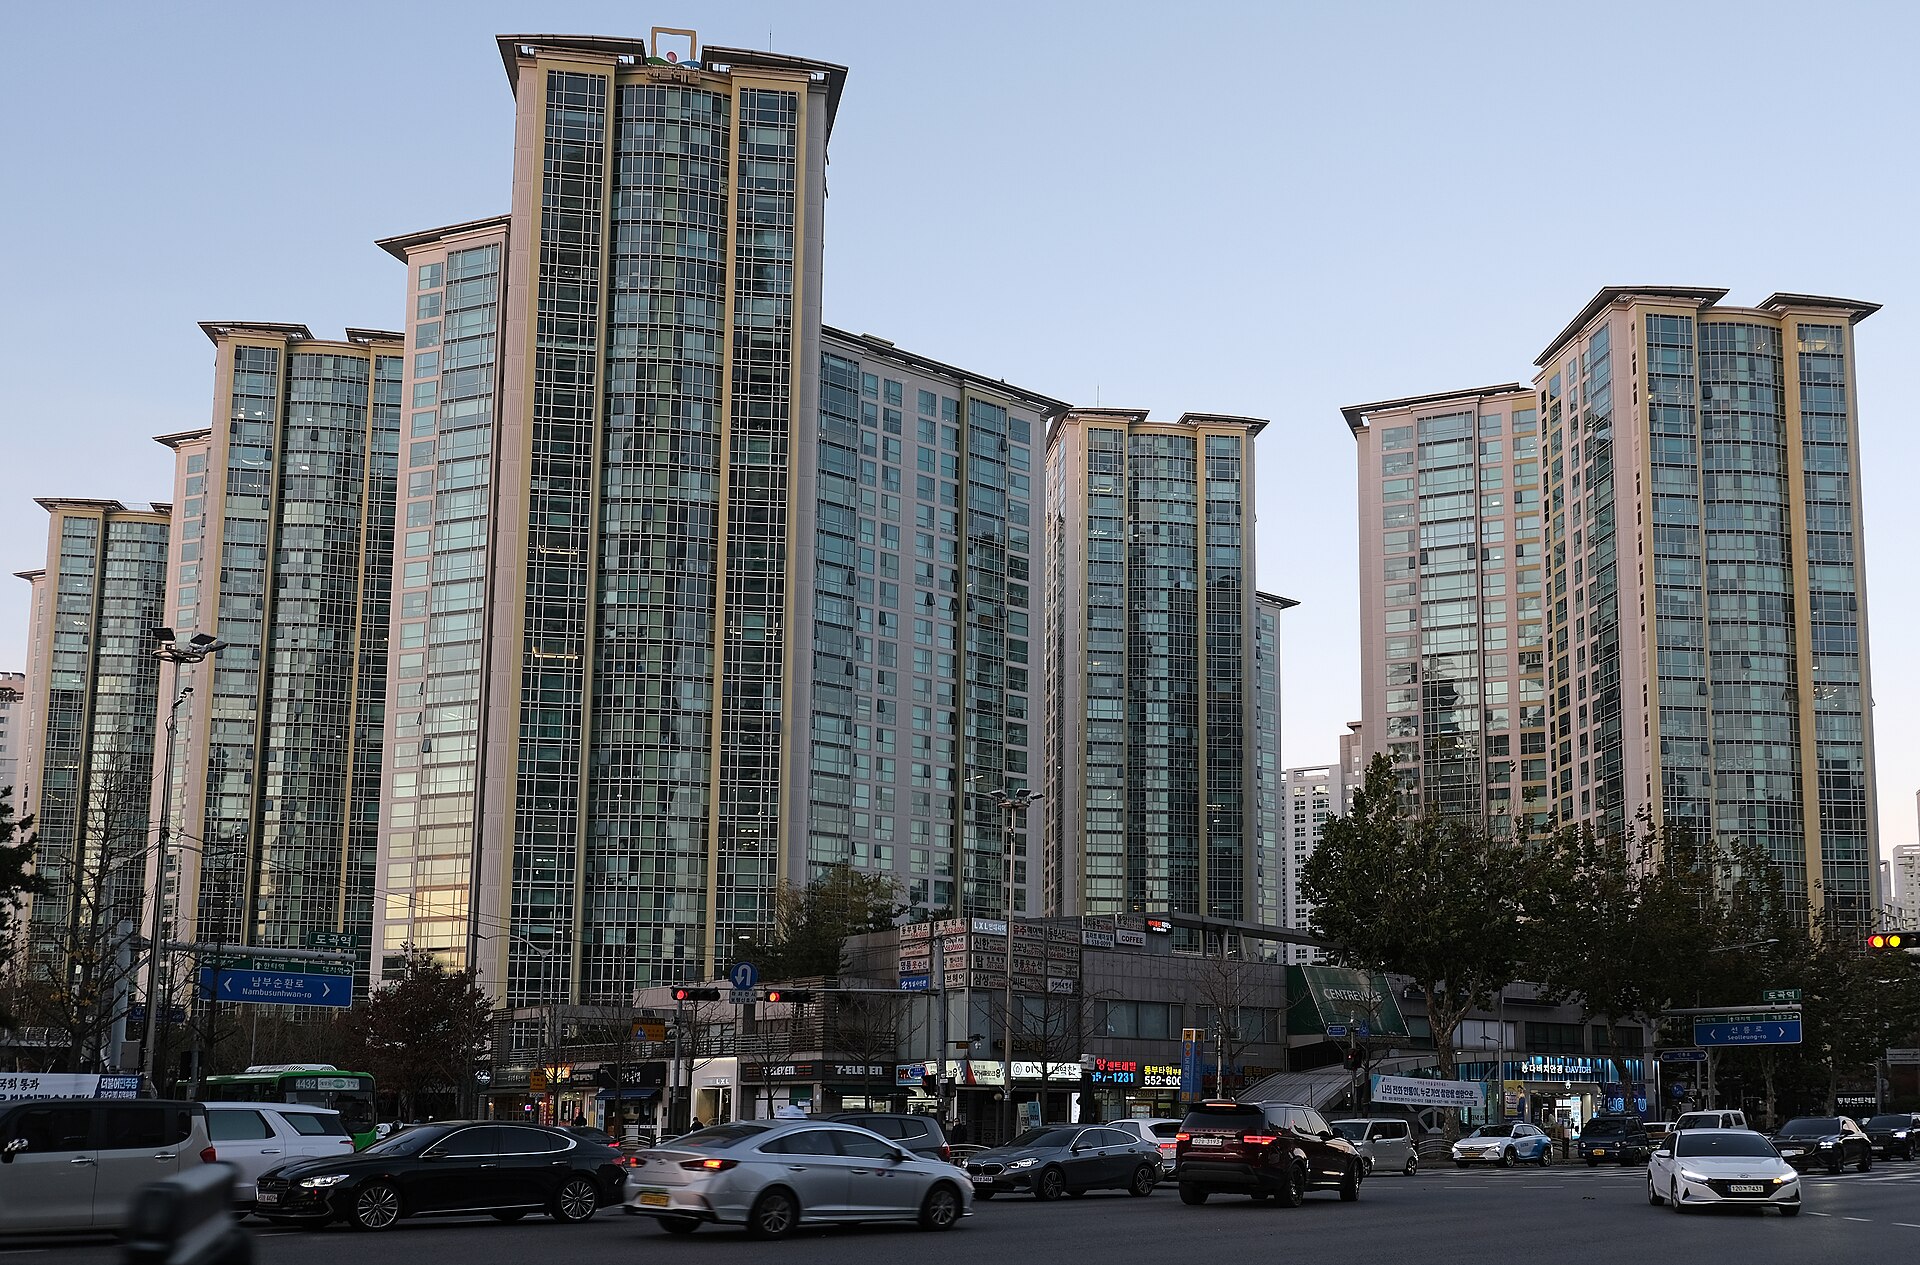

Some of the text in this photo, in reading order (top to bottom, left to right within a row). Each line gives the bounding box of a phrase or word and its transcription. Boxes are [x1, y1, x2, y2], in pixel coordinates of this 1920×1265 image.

[315, 934, 351, 947] 도곡역
[1122, 935, 1143, 944] COFFEE
[252, 976, 305, 990] 남부순환로
[242, 988, 312, 1000] Nambusunhwan-ro
[1768, 991, 1795, 1000] 도곡역
[1529, 1065, 1592, 1074] 다비치안경 DAVICH
[20, 1078, 39, 1091] 통과
[100, 1077, 138, 1090] 더불어민주당
[295, 1079, 316, 1089] 4432
